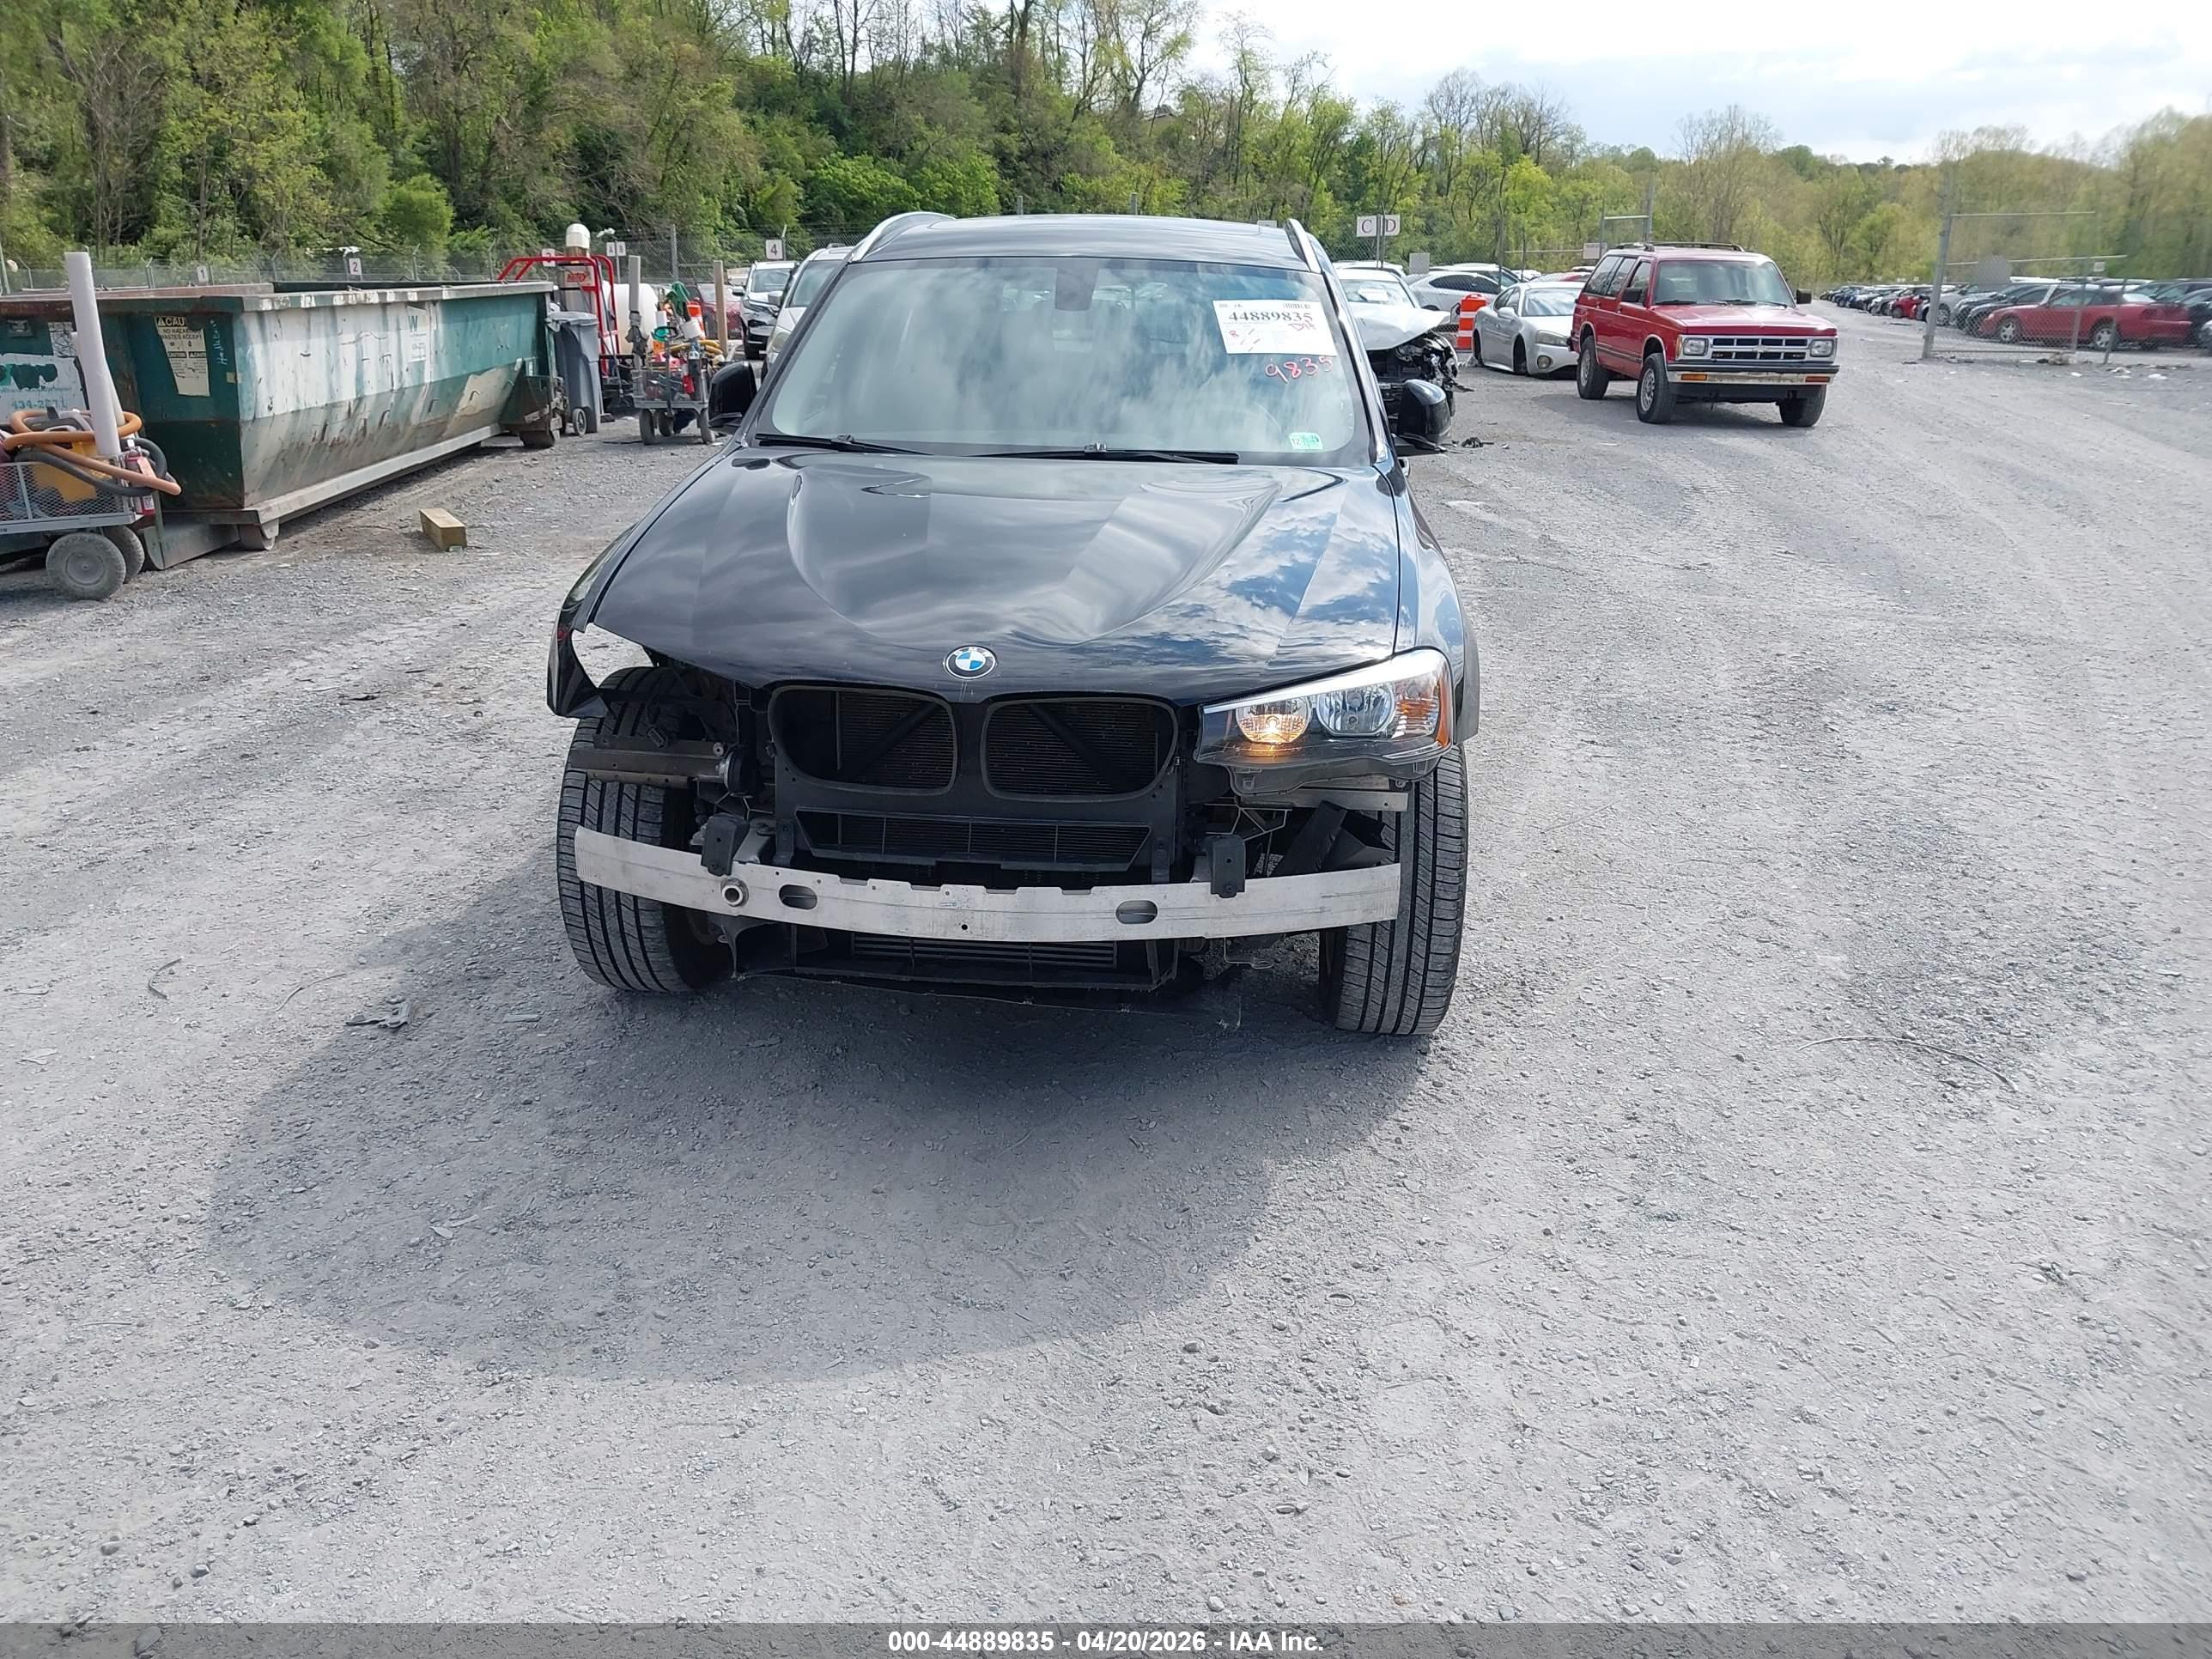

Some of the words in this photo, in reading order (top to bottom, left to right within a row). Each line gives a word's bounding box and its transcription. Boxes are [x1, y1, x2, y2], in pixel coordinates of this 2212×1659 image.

[1361, 219, 1372, 233] C
[1385, 219, 1396, 232] D
[770, 244, 777, 256] 4
[353, 261, 358, 272] 2
[165, 316, 185, 326] CAU
[1229, 311, 1314, 321] 44889835
[1265, 356, 1334, 384] 9835
